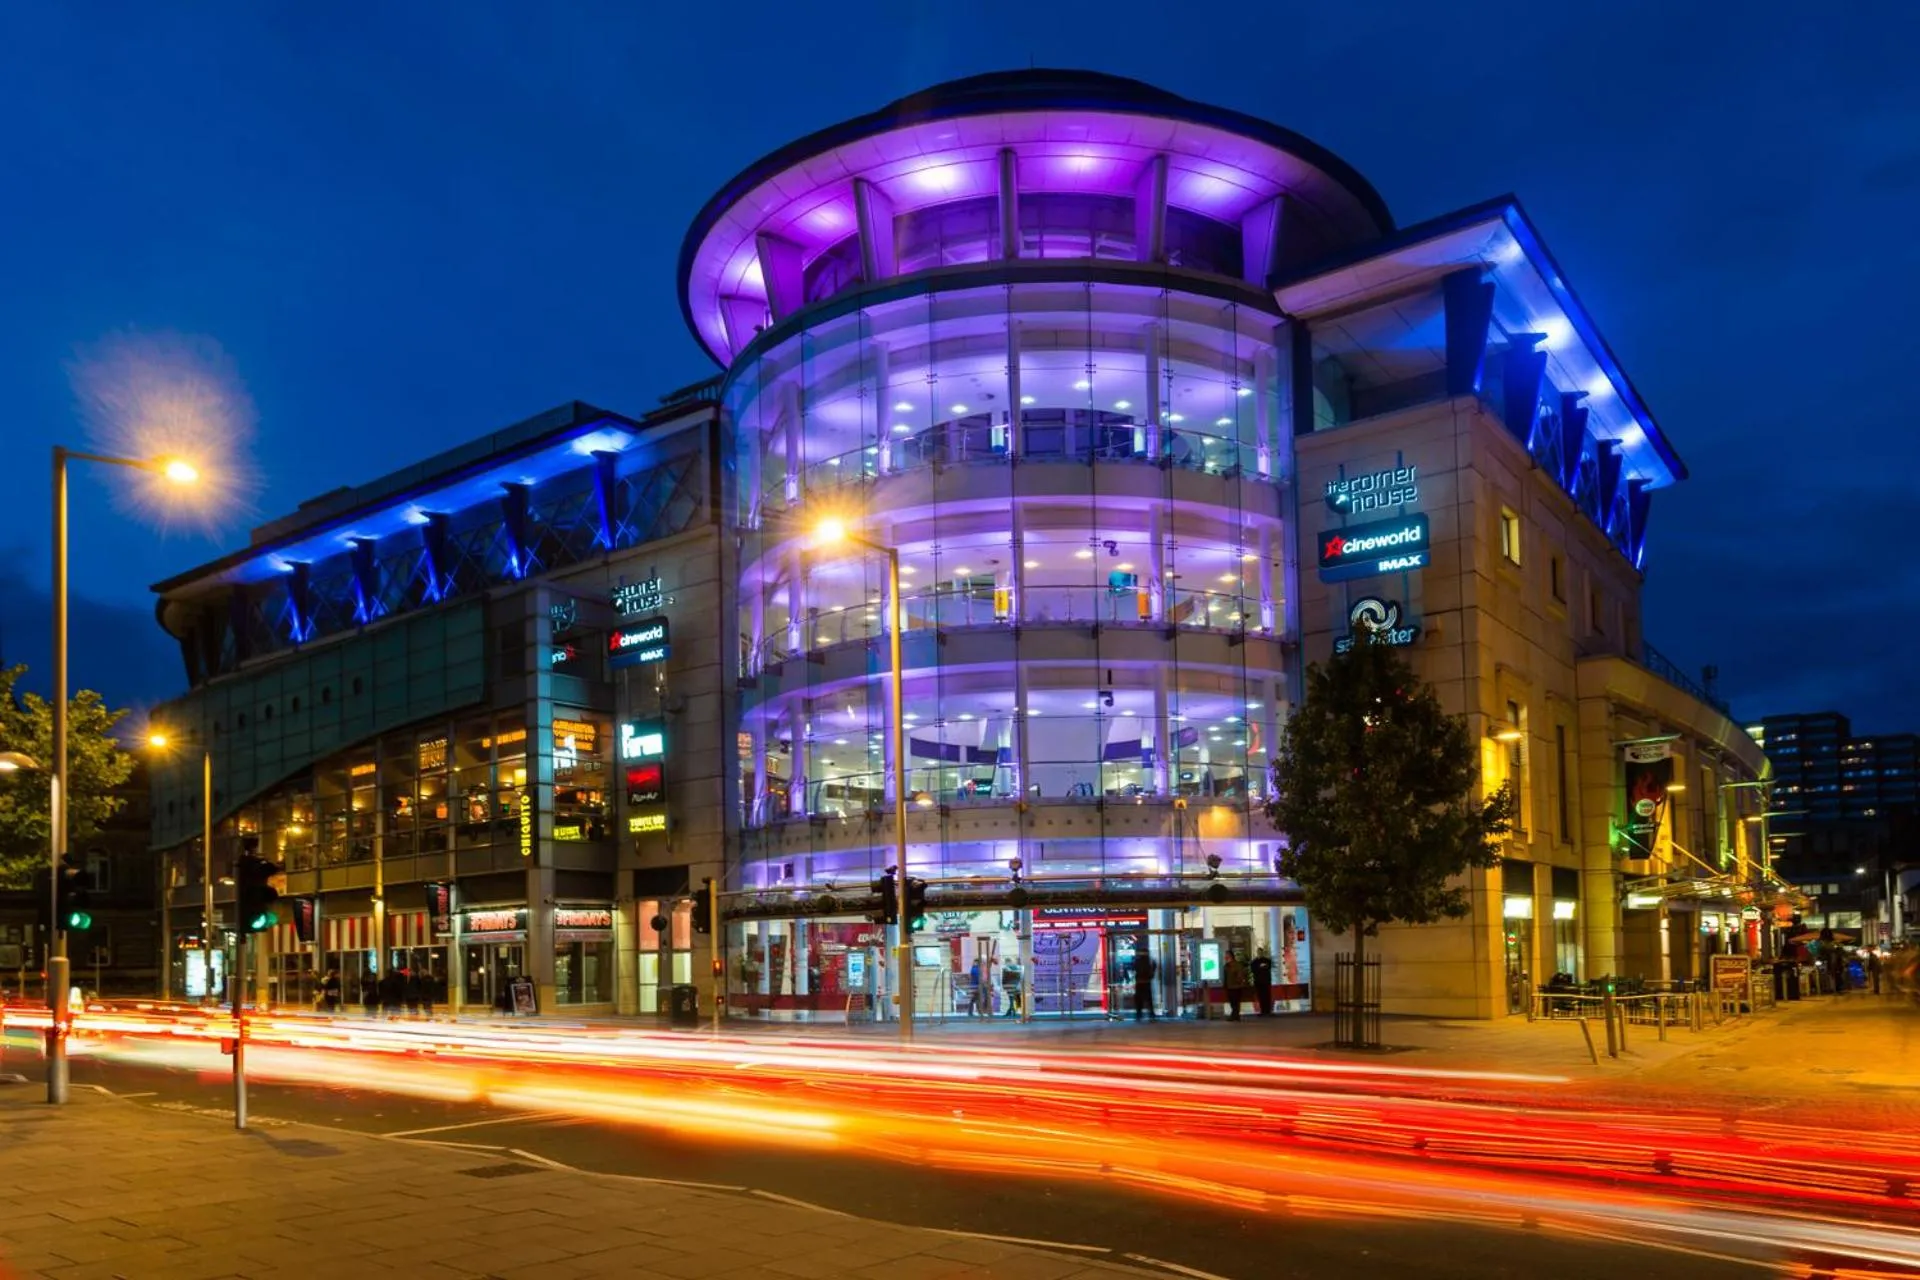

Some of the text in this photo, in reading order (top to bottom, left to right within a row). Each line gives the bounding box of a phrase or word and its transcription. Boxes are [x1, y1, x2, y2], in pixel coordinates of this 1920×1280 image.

[1350, 465, 1416, 494] corner
[1352, 485, 1418, 515] house
[1342, 526, 1420, 554] cineworld
[1378, 555, 1421, 572] IMAX
[620, 626, 663, 647] cineworld
[521, 795, 531, 856] CHIQUITO
